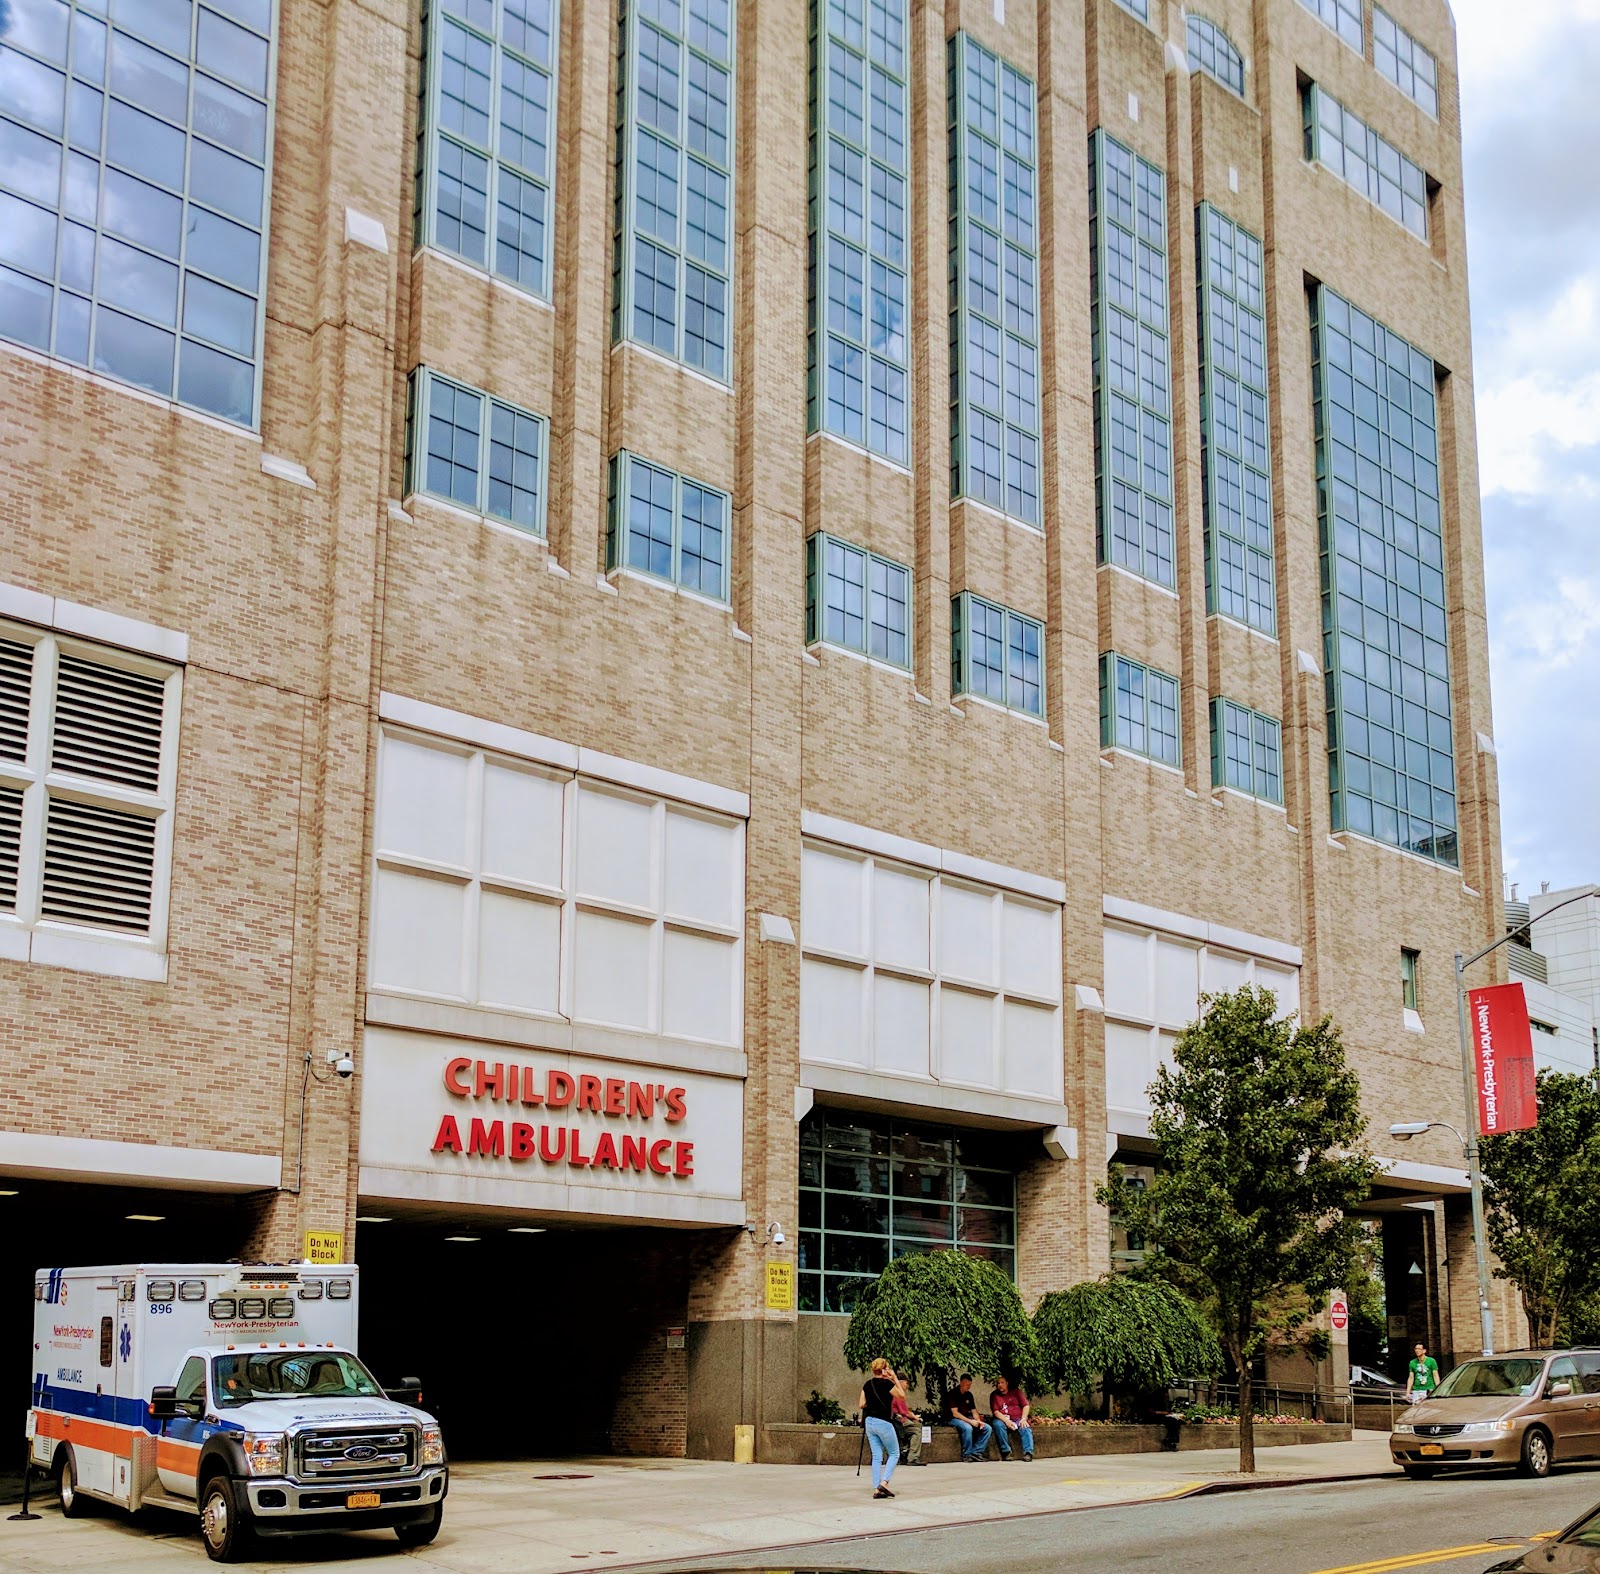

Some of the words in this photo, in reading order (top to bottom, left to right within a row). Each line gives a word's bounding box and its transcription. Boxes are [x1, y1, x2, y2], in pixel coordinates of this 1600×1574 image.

[1477, 1004, 1497, 1130] NewYork-Presbyterian
[443, 1057, 688, 1122] CHILDREN'S
[430, 1115, 695, 1176] AMBULANCE
[310, 1238, 321, 1248] Do
[324, 1239, 339, 1249] Not
[311, 1249, 336, 1259] Block
[779, 1268, 789, 1276] Not
[150, 1303, 173, 1315] 896
[213, 1320, 299, 1329] NewYork-Presbyterian
[53, 1324, 94, 1343] NewYork-Presbyterian
[57, 1367, 82, 1383] AMBULANCE
[352, 1448, 372, 1457] Ford
